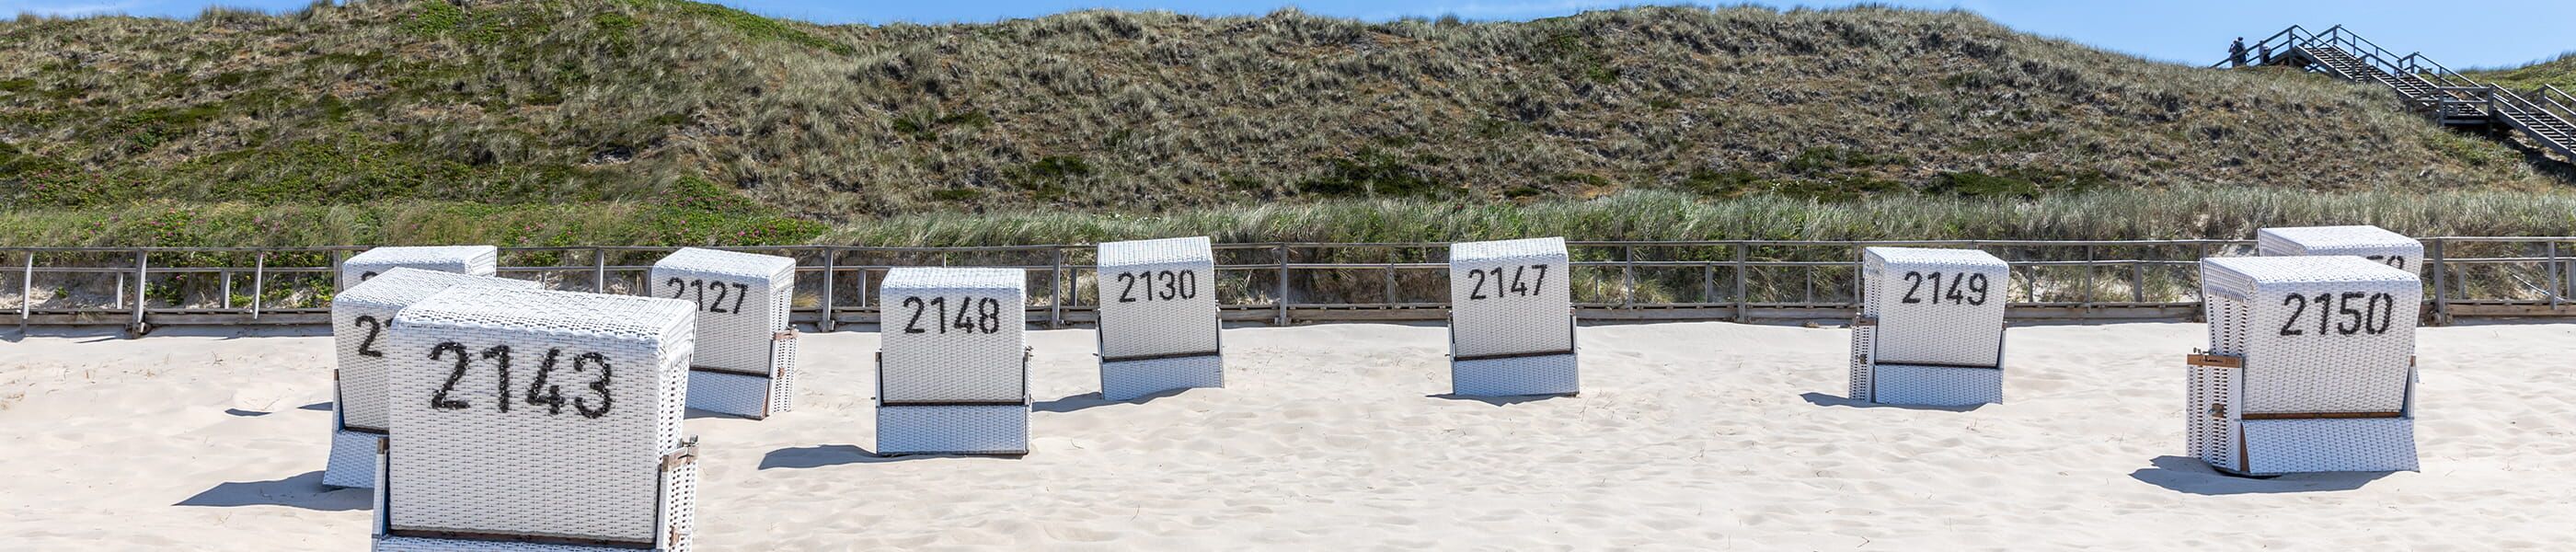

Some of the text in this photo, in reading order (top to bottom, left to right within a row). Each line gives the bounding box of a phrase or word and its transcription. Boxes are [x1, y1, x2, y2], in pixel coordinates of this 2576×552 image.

[667, 277, 749, 314] 2127
[1118, 269, 1196, 304] 2130
[1468, 264, 1547, 301] 2147
[1902, 270, 1987, 305] 2149
[903, 296, 1000, 334] 2148
[2280, 292, 2392, 336] 2150
[428, 340, 614, 420] 2143
